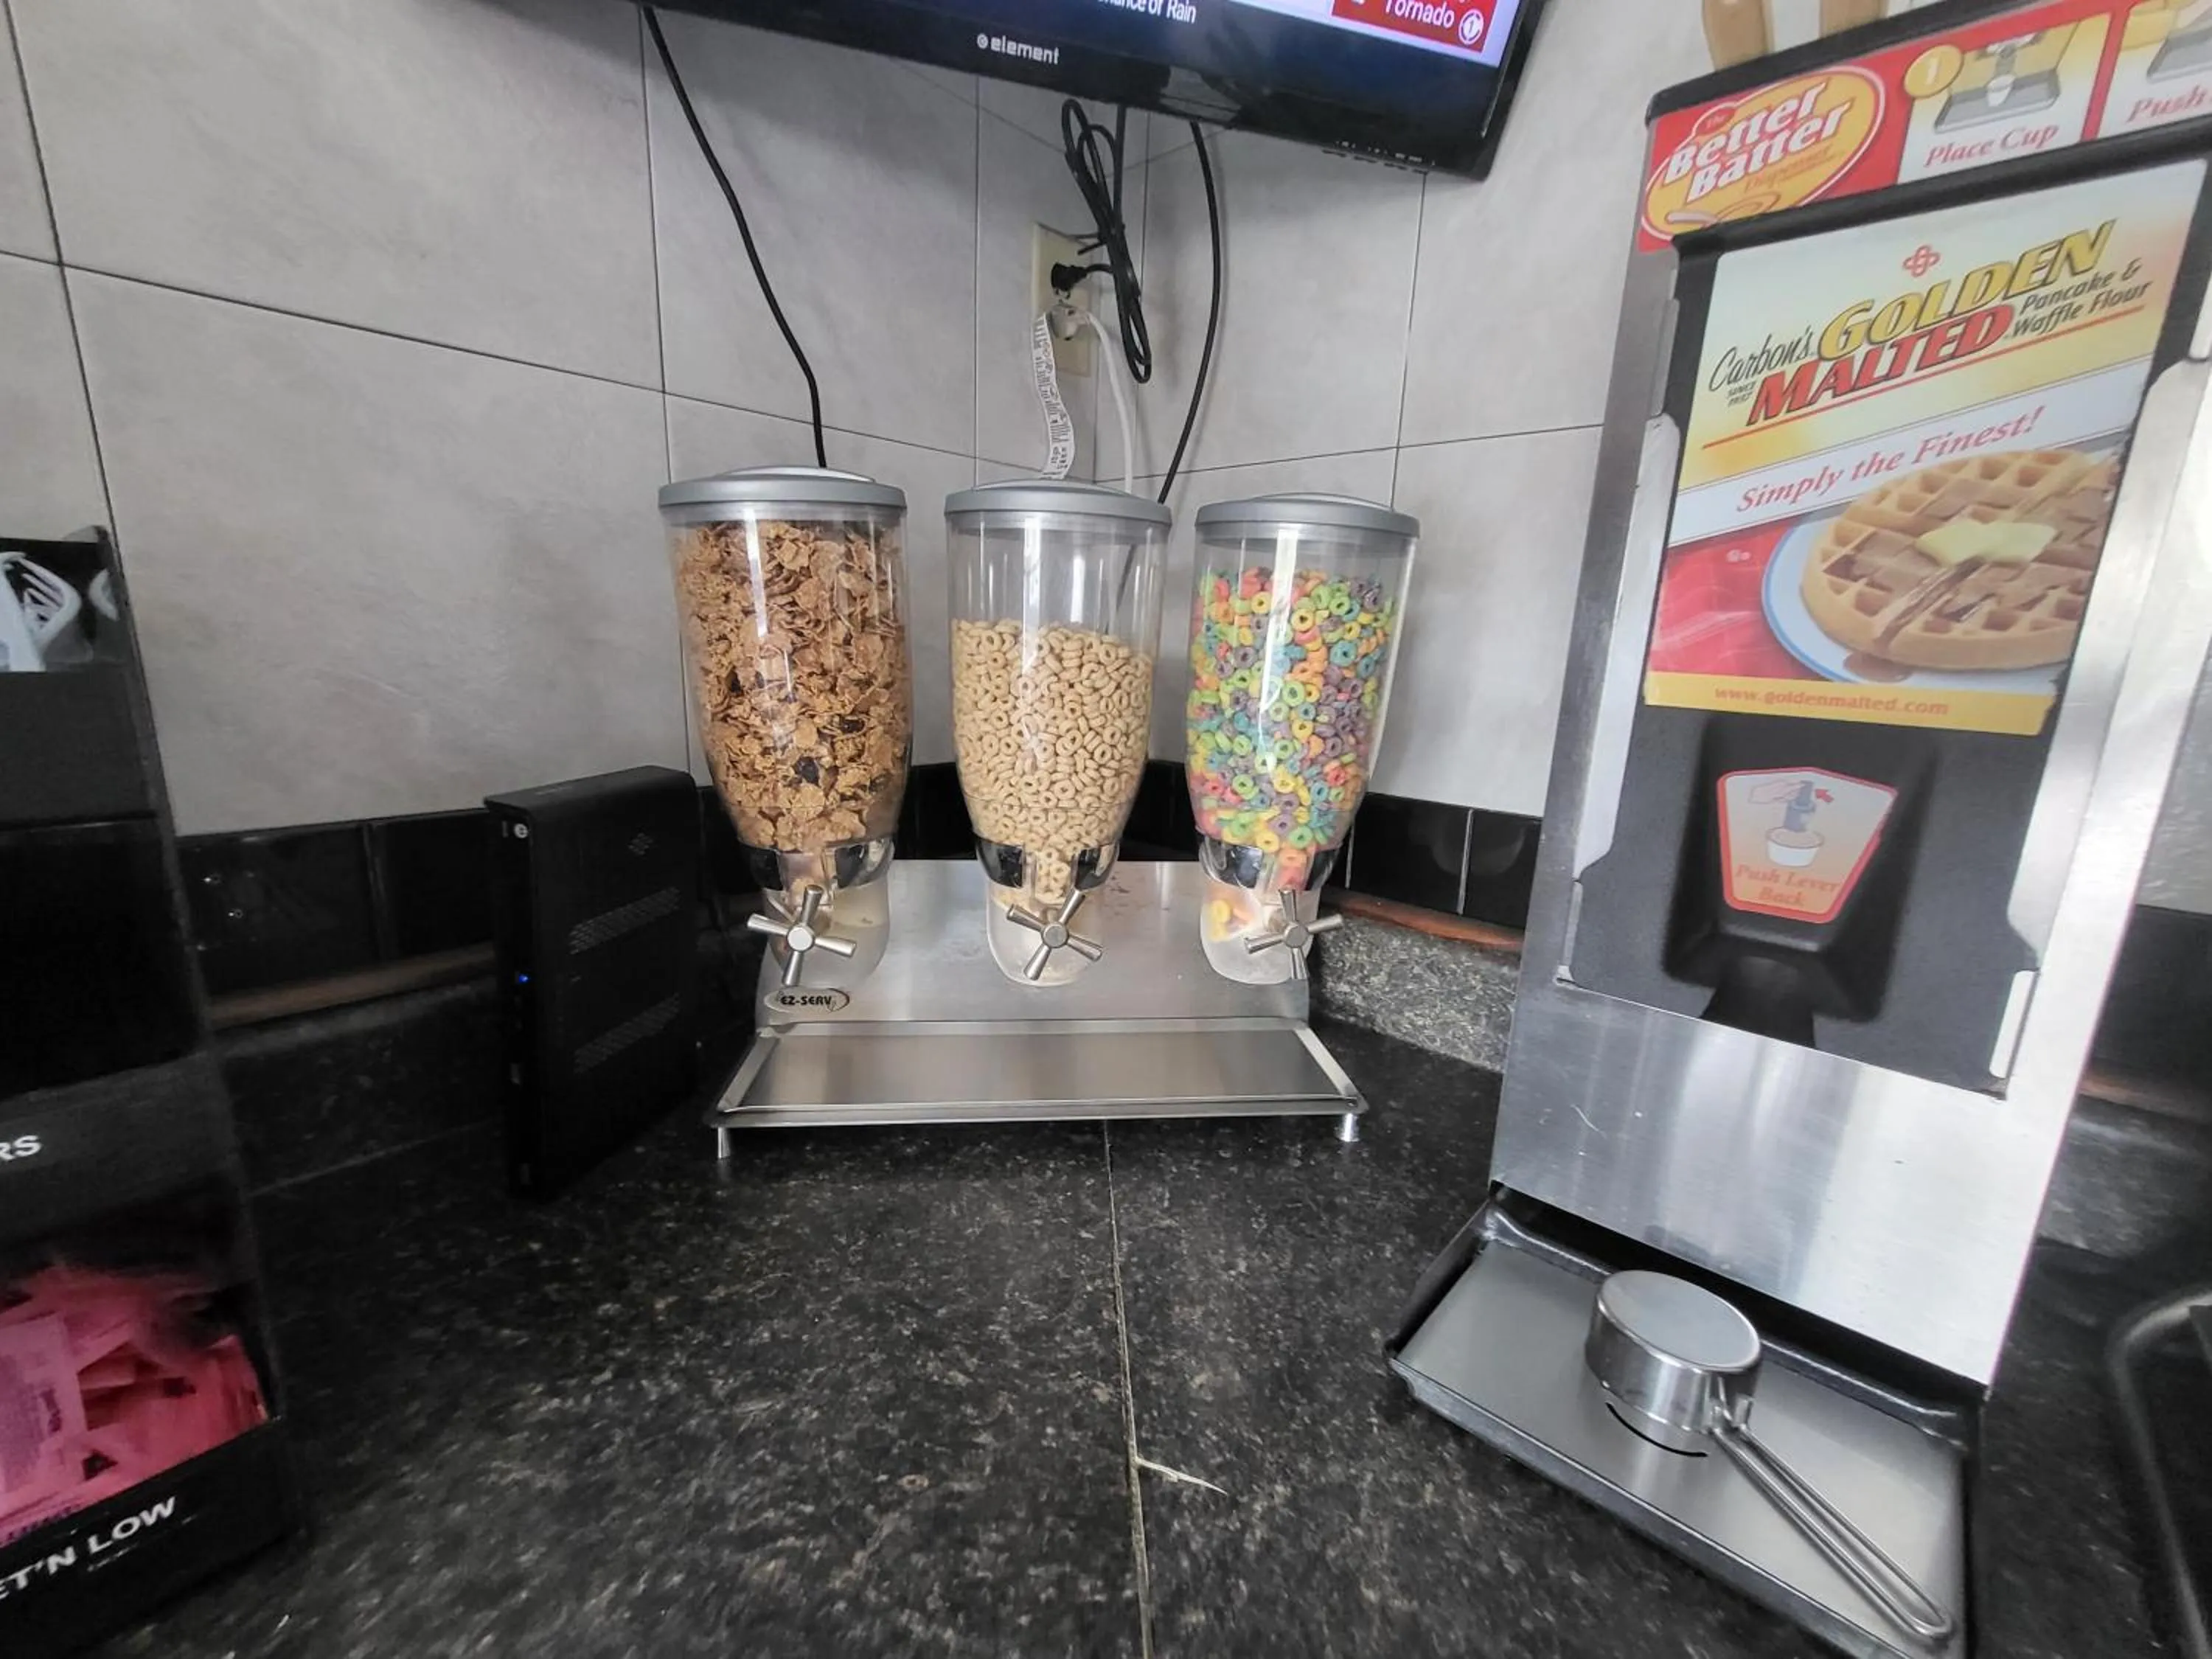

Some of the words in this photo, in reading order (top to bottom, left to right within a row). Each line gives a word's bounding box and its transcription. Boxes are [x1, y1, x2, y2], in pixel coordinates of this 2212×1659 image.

[1166, 0, 1196, 24] Rain
[1385, 0, 1455, 28] Tornado
[990, 35, 1060, 64] element
[1663, 80, 1829, 184] Better
[2126, 85, 2207, 123] Push
[1686, 99, 1855, 204] Batter
[1924, 139, 1992, 168] Place
[2000, 124, 2059, 150] Cup
[1817, 218, 2118, 361] GOLDEN
[2013, 304, 2084, 339] Waffle
[2087, 282, 2152, 314] Flour
[2019, 271, 2118, 316] Pancake
[2121, 258, 2143, 282] &
[1746, 304, 2014, 427] MALTED
[1736, 466, 1844, 512] Simply
[1850, 451, 1905, 481] the
[1911, 406, 2045, 465] Finest!
[1714, 687, 1950, 715] www.goldenmalted.com
[780, 995, 832, 1006] EZ-SERV
[87, 1496, 176, 1554] LOW
